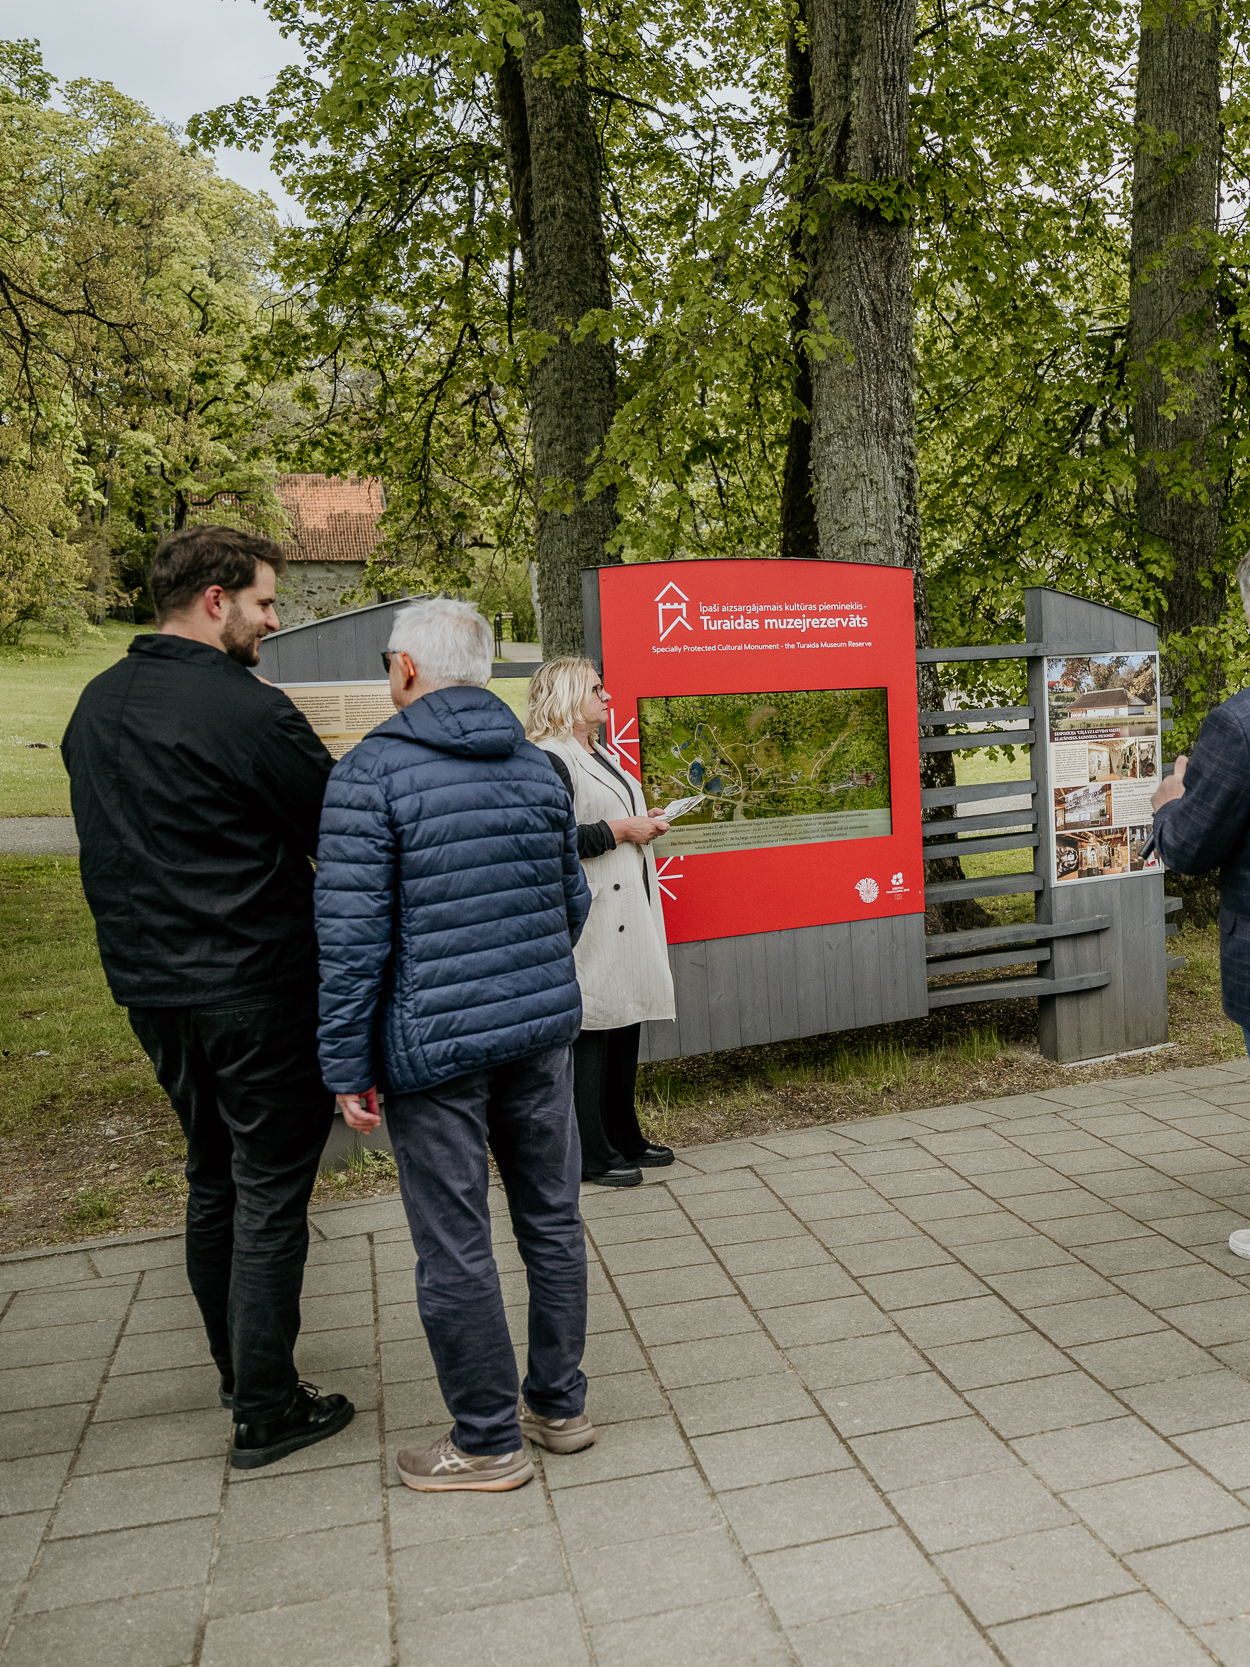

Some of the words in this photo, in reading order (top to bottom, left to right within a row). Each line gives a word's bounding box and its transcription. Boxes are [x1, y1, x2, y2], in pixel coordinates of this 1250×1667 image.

[699, 602, 720, 614] Īpaši
[721, 603, 782, 614] aizsargājamais
[784, 602, 817, 611] kultūras
[700, 614, 759, 630] Turaidas
[764, 614, 868, 632] muzejrezervāts
[652, 646, 682, 654] Specially
